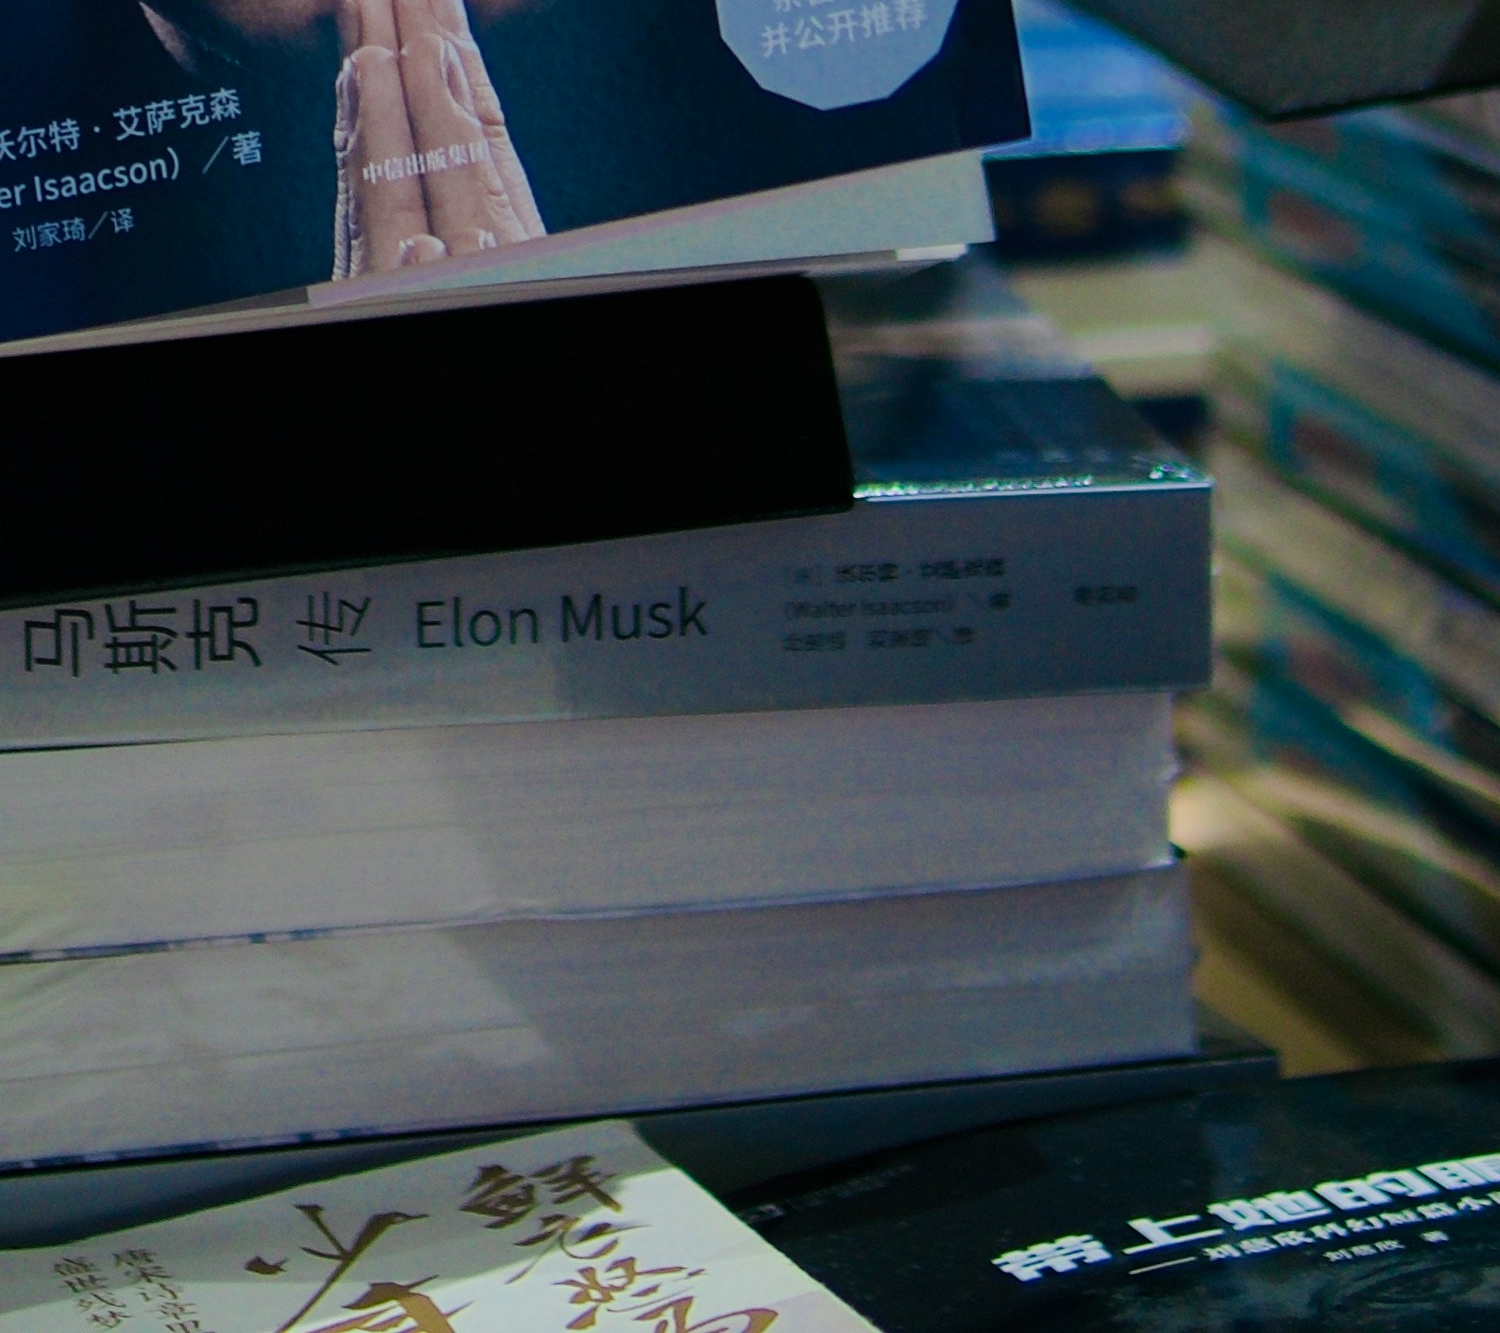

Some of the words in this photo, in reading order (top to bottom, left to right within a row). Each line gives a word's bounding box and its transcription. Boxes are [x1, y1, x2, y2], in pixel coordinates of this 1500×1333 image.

[34, 146, 181, 204] Isaacson)
[415, 598, 541, 650] Elon
[560, 585, 709, 644] Musk
